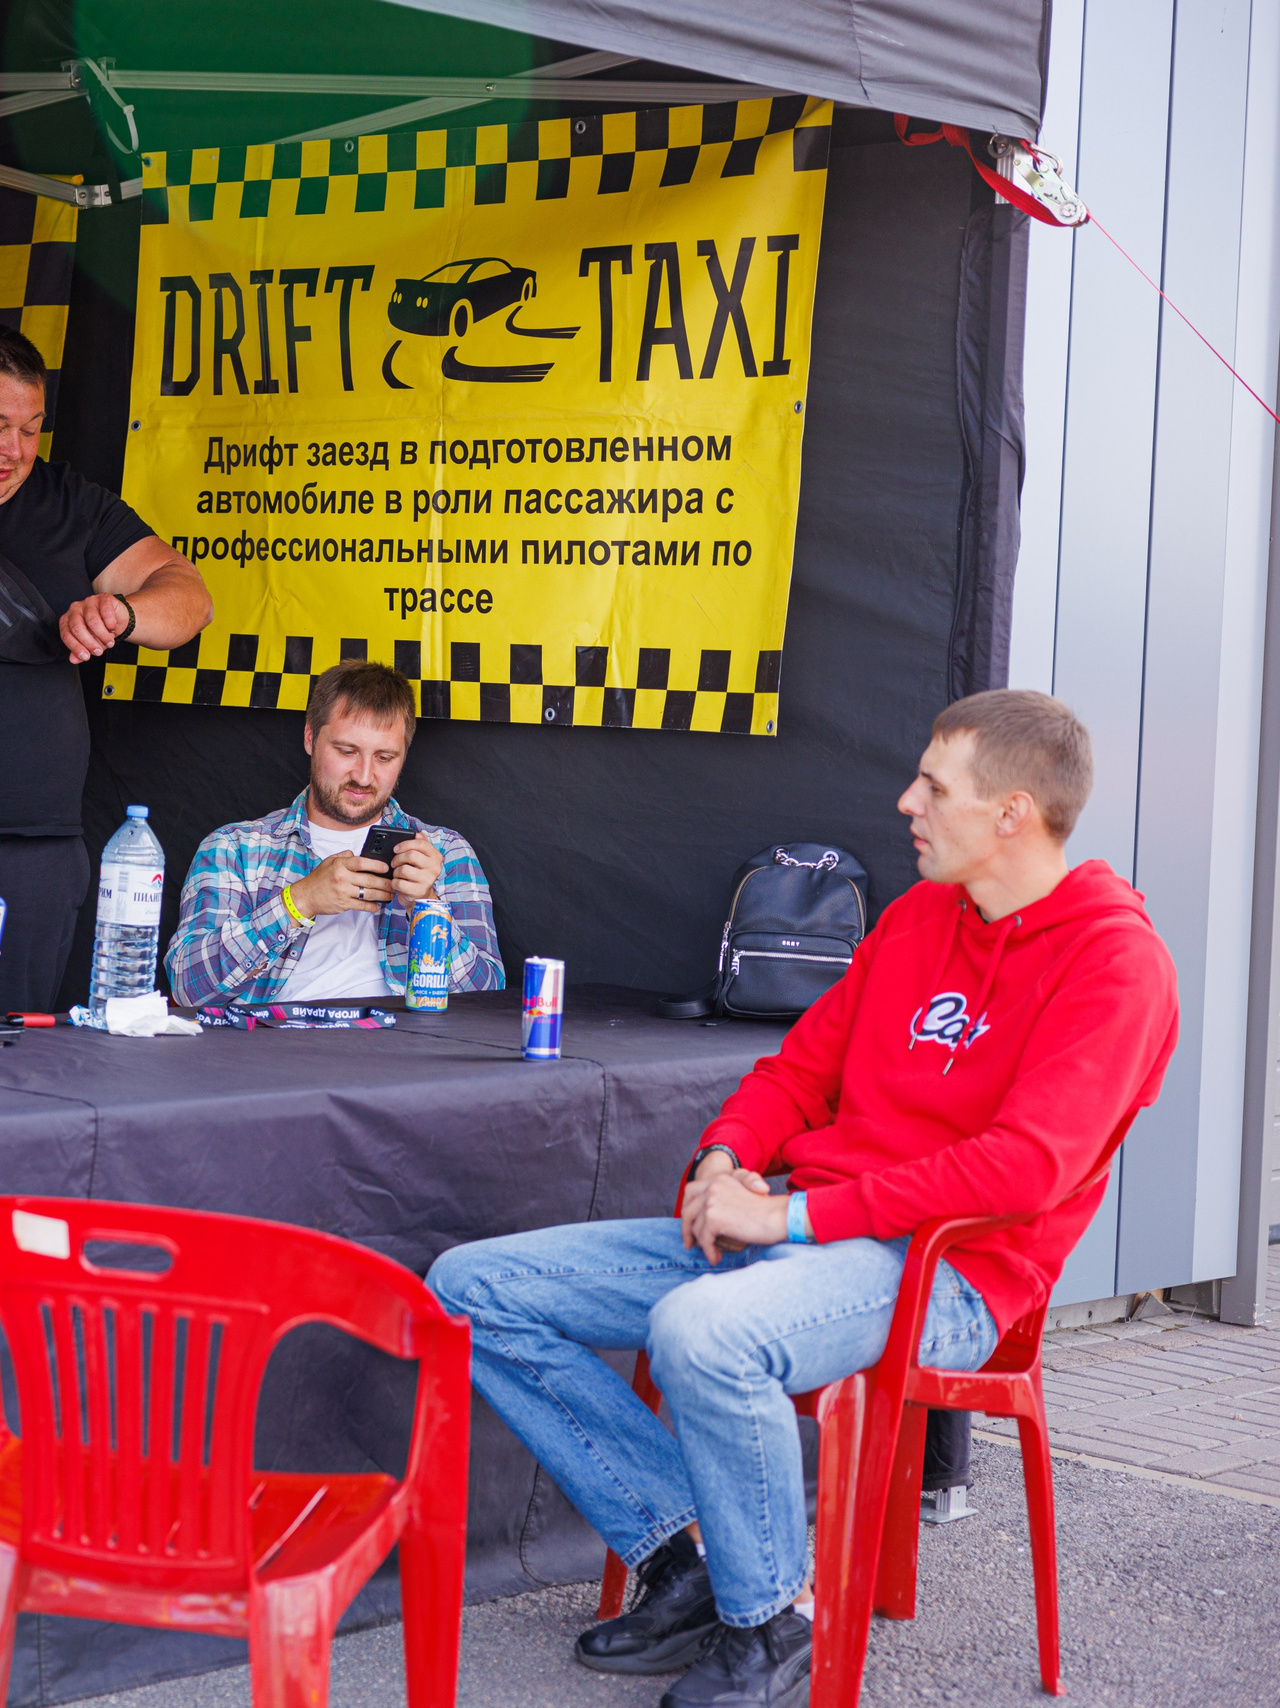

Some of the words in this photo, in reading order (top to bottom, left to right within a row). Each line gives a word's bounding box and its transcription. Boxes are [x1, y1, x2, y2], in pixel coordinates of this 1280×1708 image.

[160, 265, 375, 397] DRIFT
[579, 234, 800, 383] TAXI
[204, 436, 298, 475] Дрифт
[307, 442, 389, 471] заезд
[401, 442, 418, 465] в
[430, 436, 732, 469] подготовленном
[197, 482, 374, 514] автомобиле
[386, 491, 402, 514] в
[414, 490, 492, 522] роли
[505, 489, 703, 522] пассажира
[716, 490, 734, 514] с
[172, 530, 508, 568] профессиональными
[522, 540, 700, 566] пилотами
[713, 541, 752, 567] по
[384, 588, 493, 619] трассе
[292, 1007, 324, 1017] ДРАЙВ
[328, 1010, 360, 1019] ИГОРА
